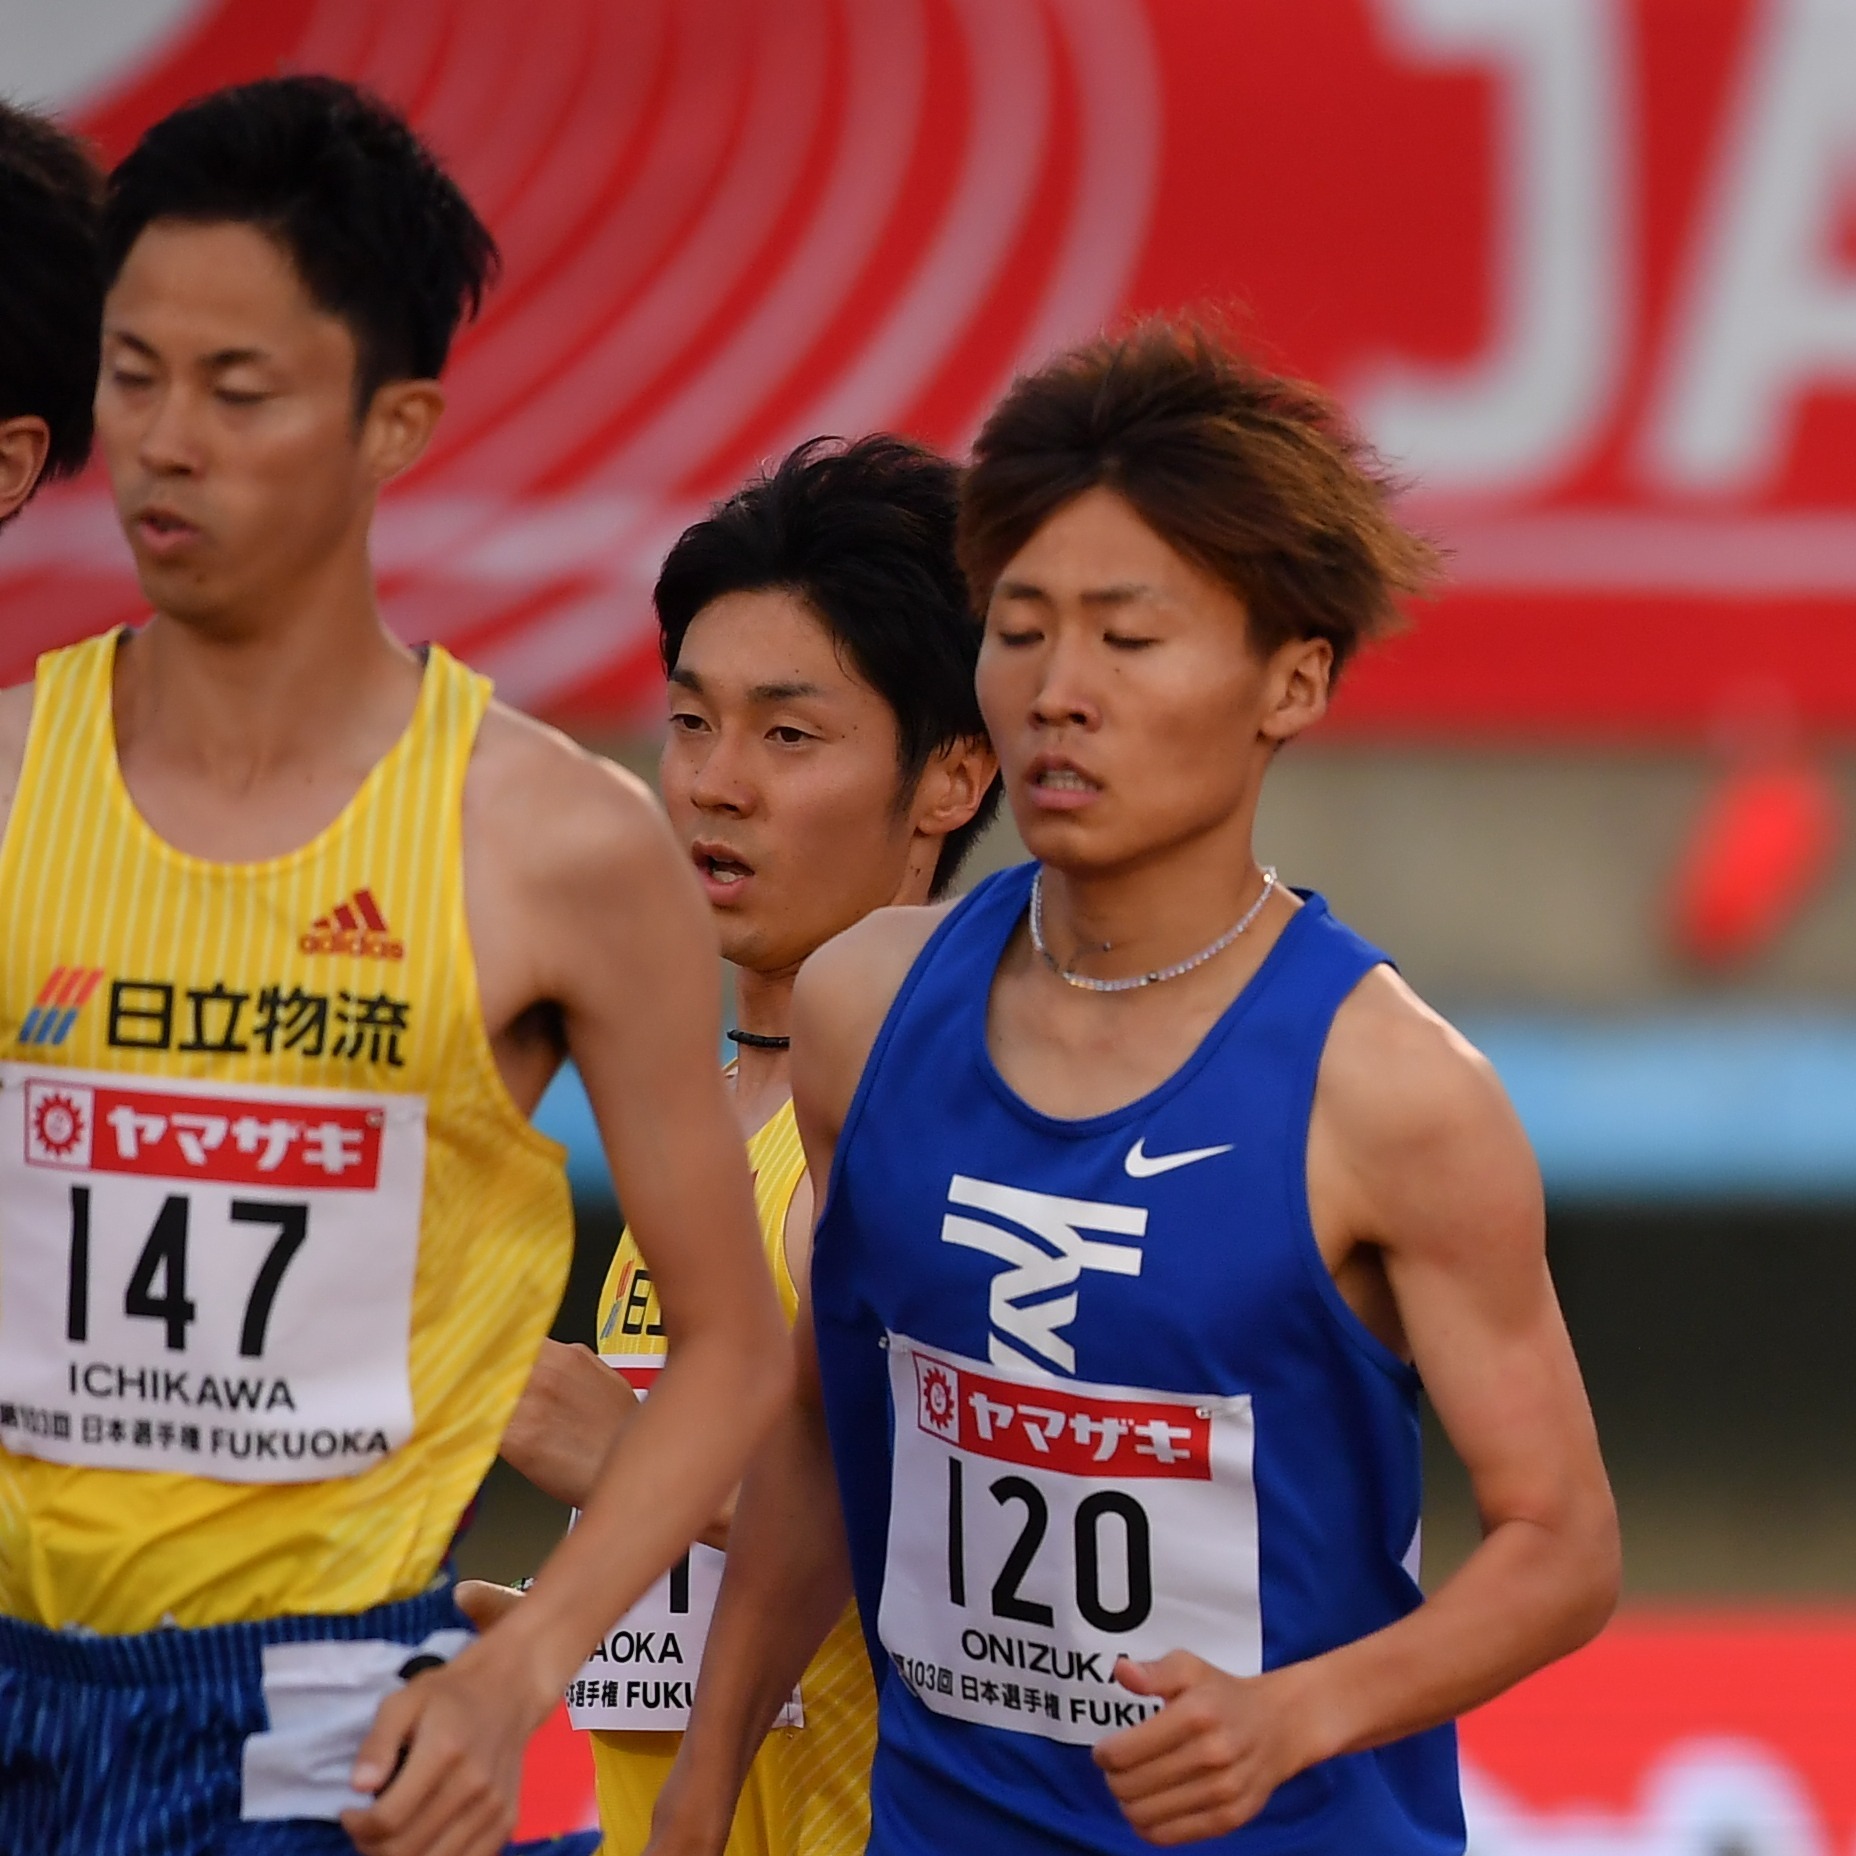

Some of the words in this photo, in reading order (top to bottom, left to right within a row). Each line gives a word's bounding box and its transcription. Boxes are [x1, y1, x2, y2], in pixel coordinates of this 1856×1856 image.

[106, 980, 411, 1068] 日立物流
[105, 1104, 364, 1176] ヤマザキ
[66, 1185, 310, 1359] 147
[68, 1361, 297, 1413] ICHIKAWA
[210, 1424, 390, 1460] FUKUOKA
[969, 1390, 1194, 1465] ヤマザキ
[947, 1456, 1154, 1634] 120
[961, 1674, 1061, 1722] 日本選手権
